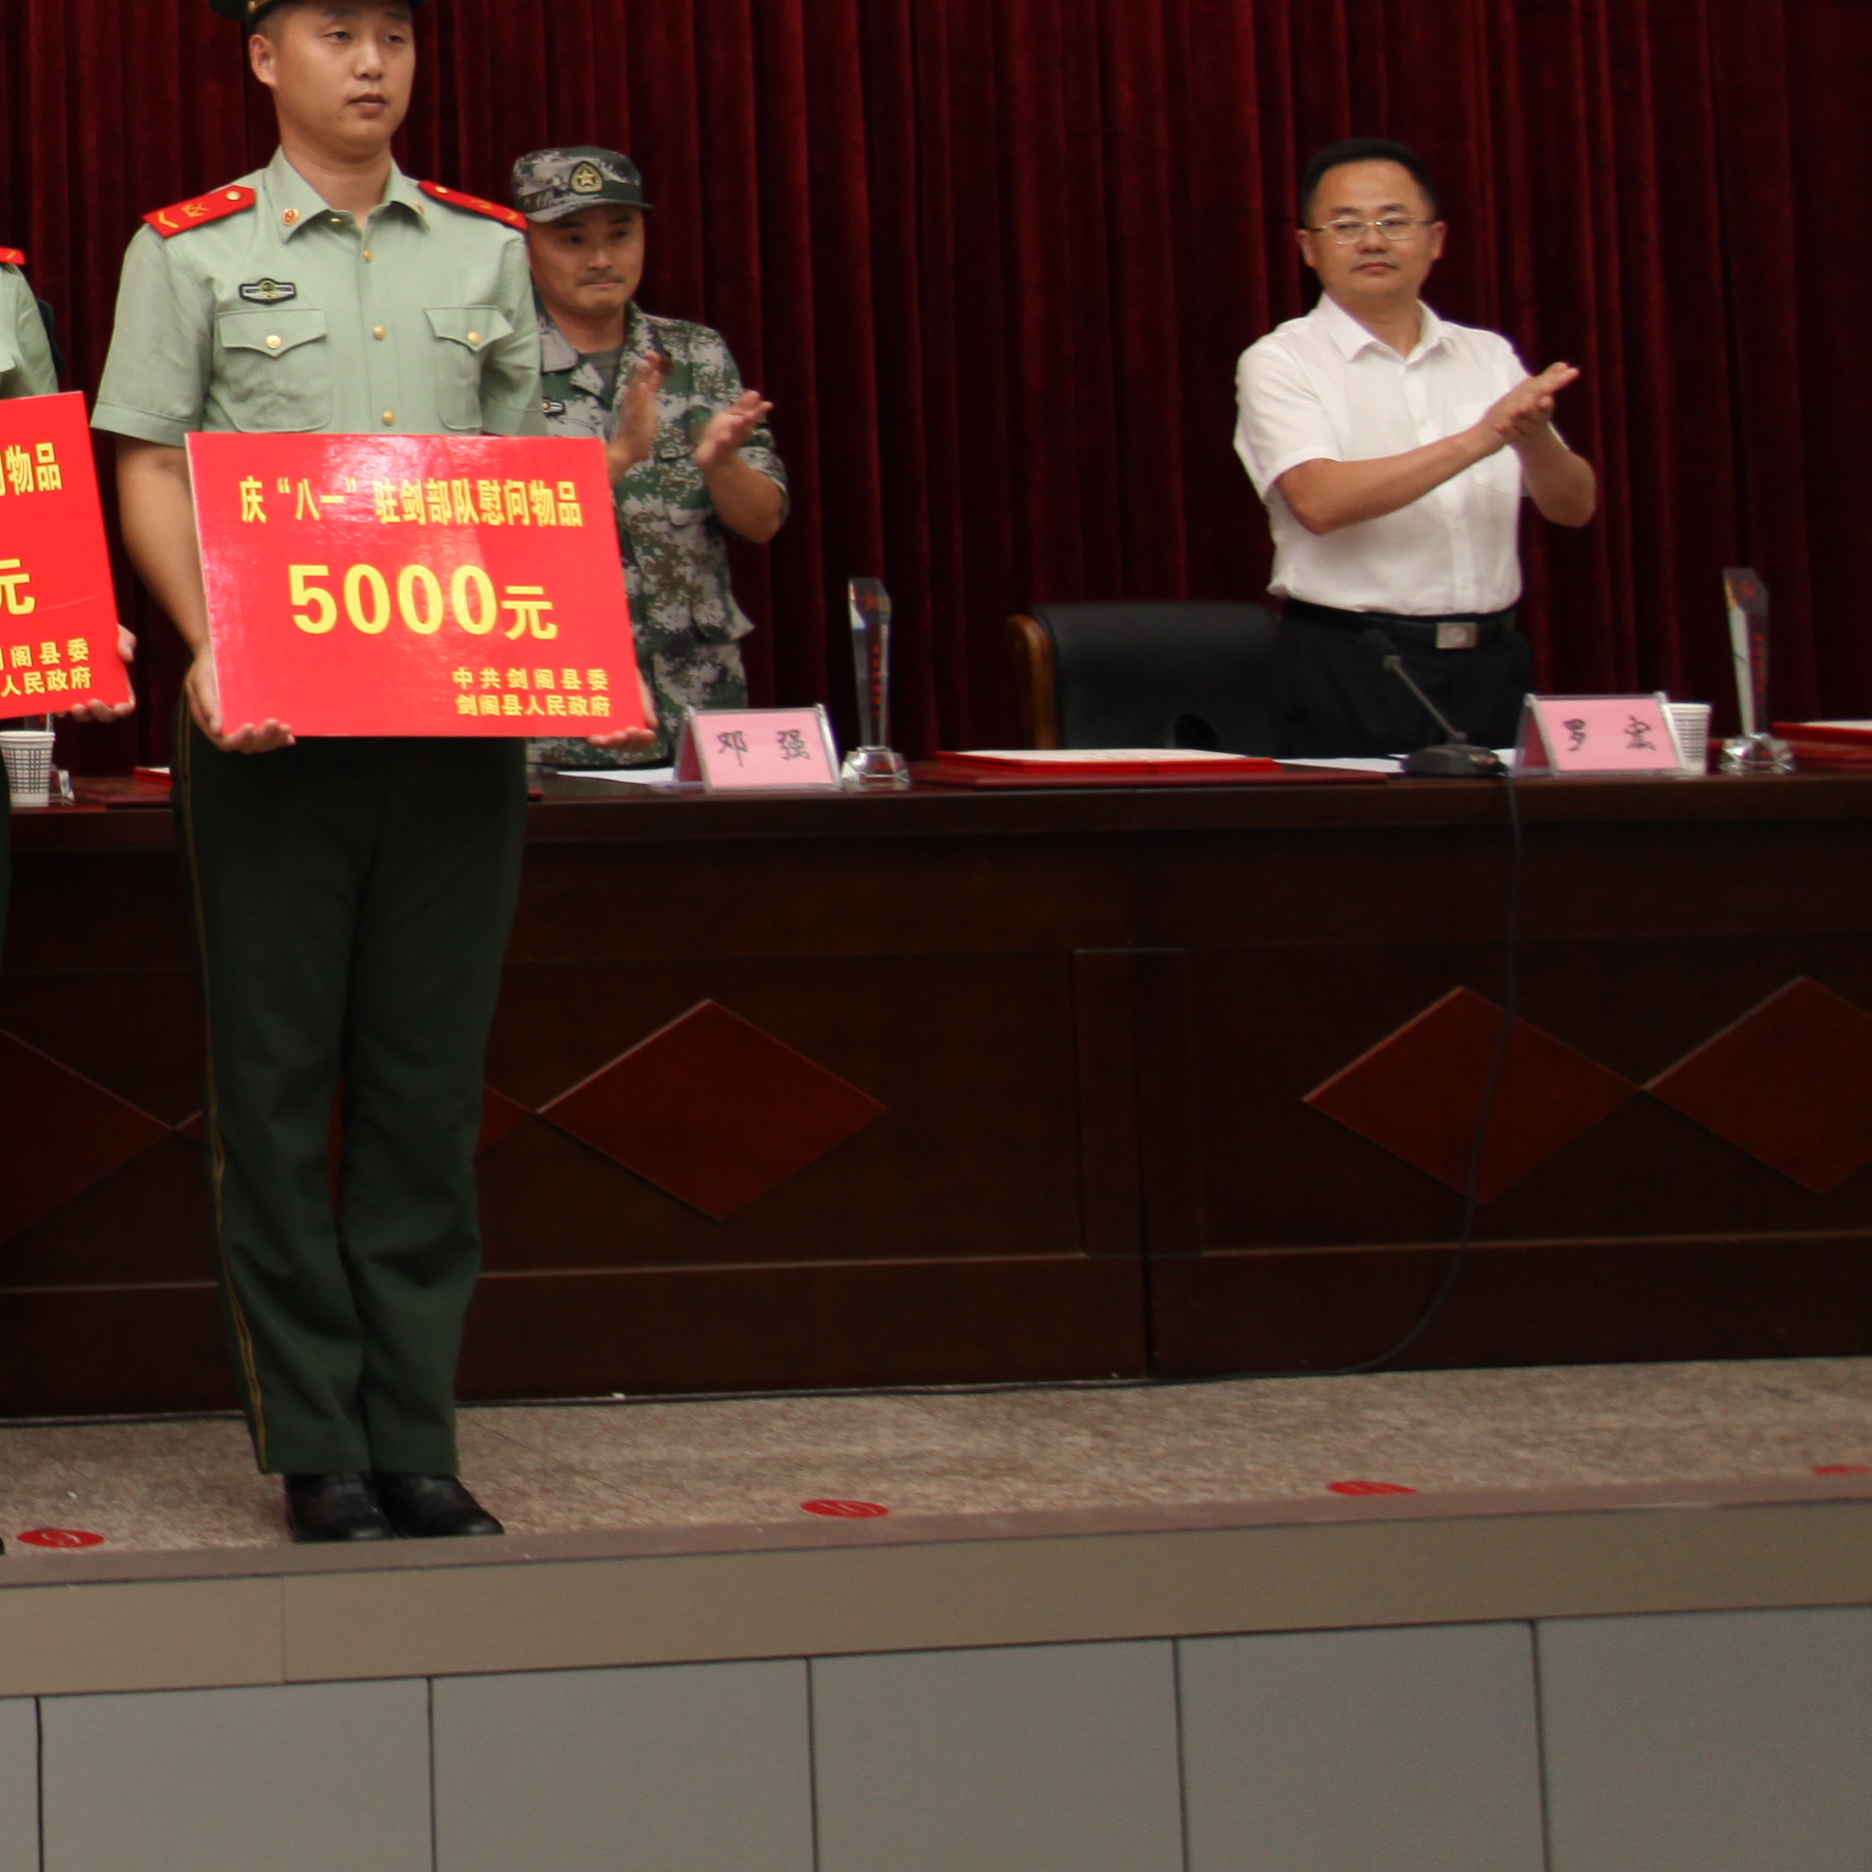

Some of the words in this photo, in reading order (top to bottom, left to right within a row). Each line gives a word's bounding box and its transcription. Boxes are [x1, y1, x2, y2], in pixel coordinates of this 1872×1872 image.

[290, 564, 557, 639] 5000元
[453, 668, 607, 690] 中共剑阁县委
[457, 695, 609, 716] 剑阁县人民政府
